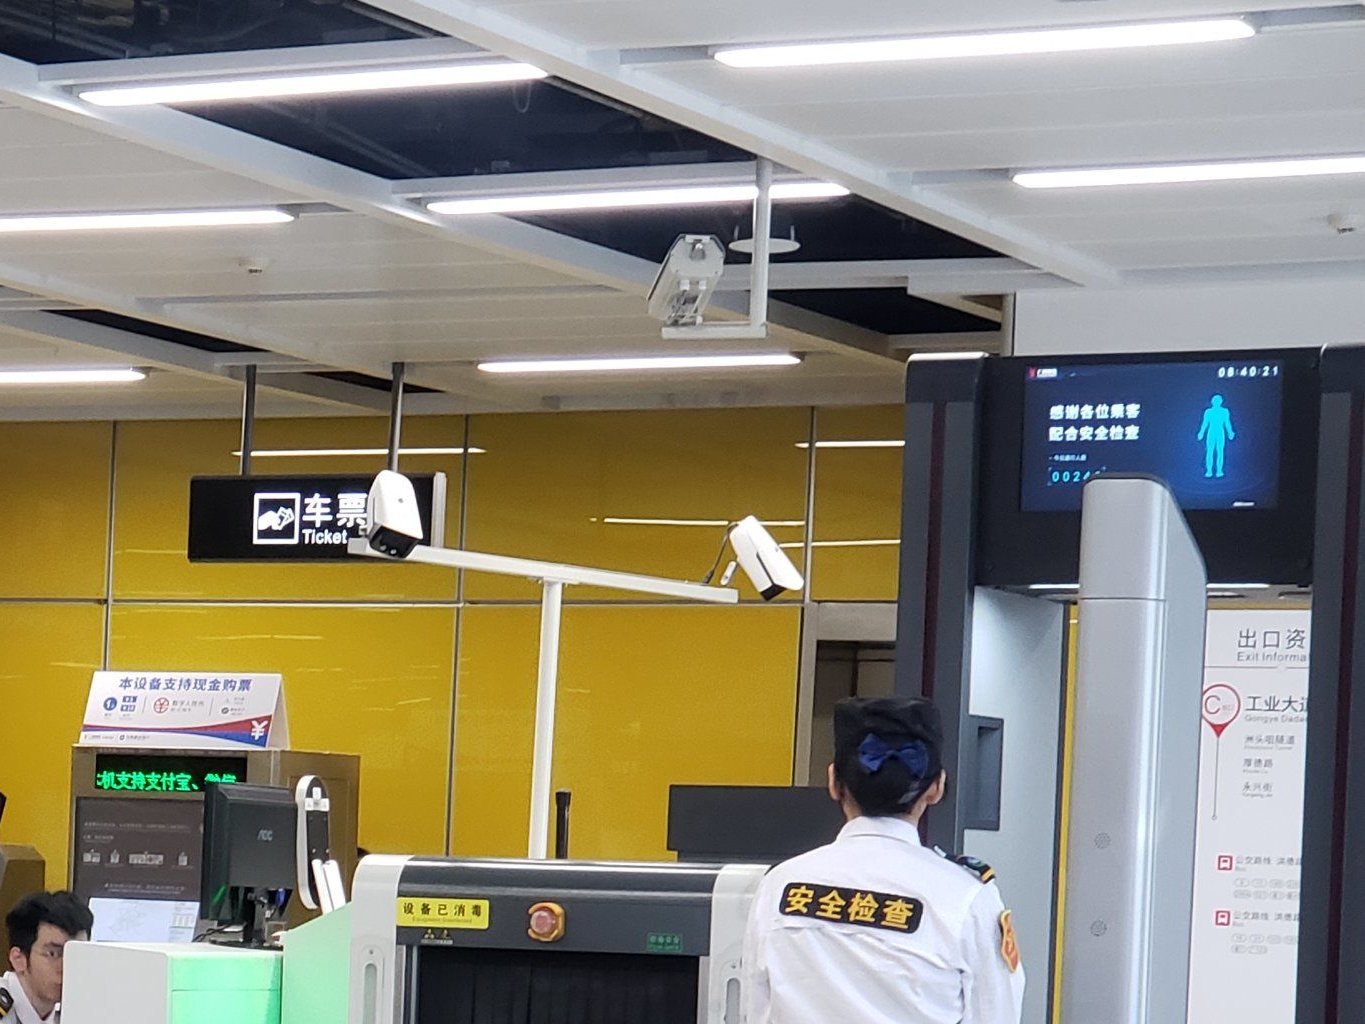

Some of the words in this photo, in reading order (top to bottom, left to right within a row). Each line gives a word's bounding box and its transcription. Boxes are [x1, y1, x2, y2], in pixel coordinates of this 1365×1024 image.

[1049, 403, 1141, 420] 感谢各位乘客
[1048, 425, 1140, 442] 配合安全检查
[302, 492, 368, 527] 车票
[302, 528, 348, 545] Ticket
[1237, 651, 1259, 662] Exit
[119, 676, 253, 692] 本设备支持现金购票
[1204, 694, 1221, 715] C
[402, 902, 483, 917] 设备已消毒
[785, 885, 915, 930] 安全检查
